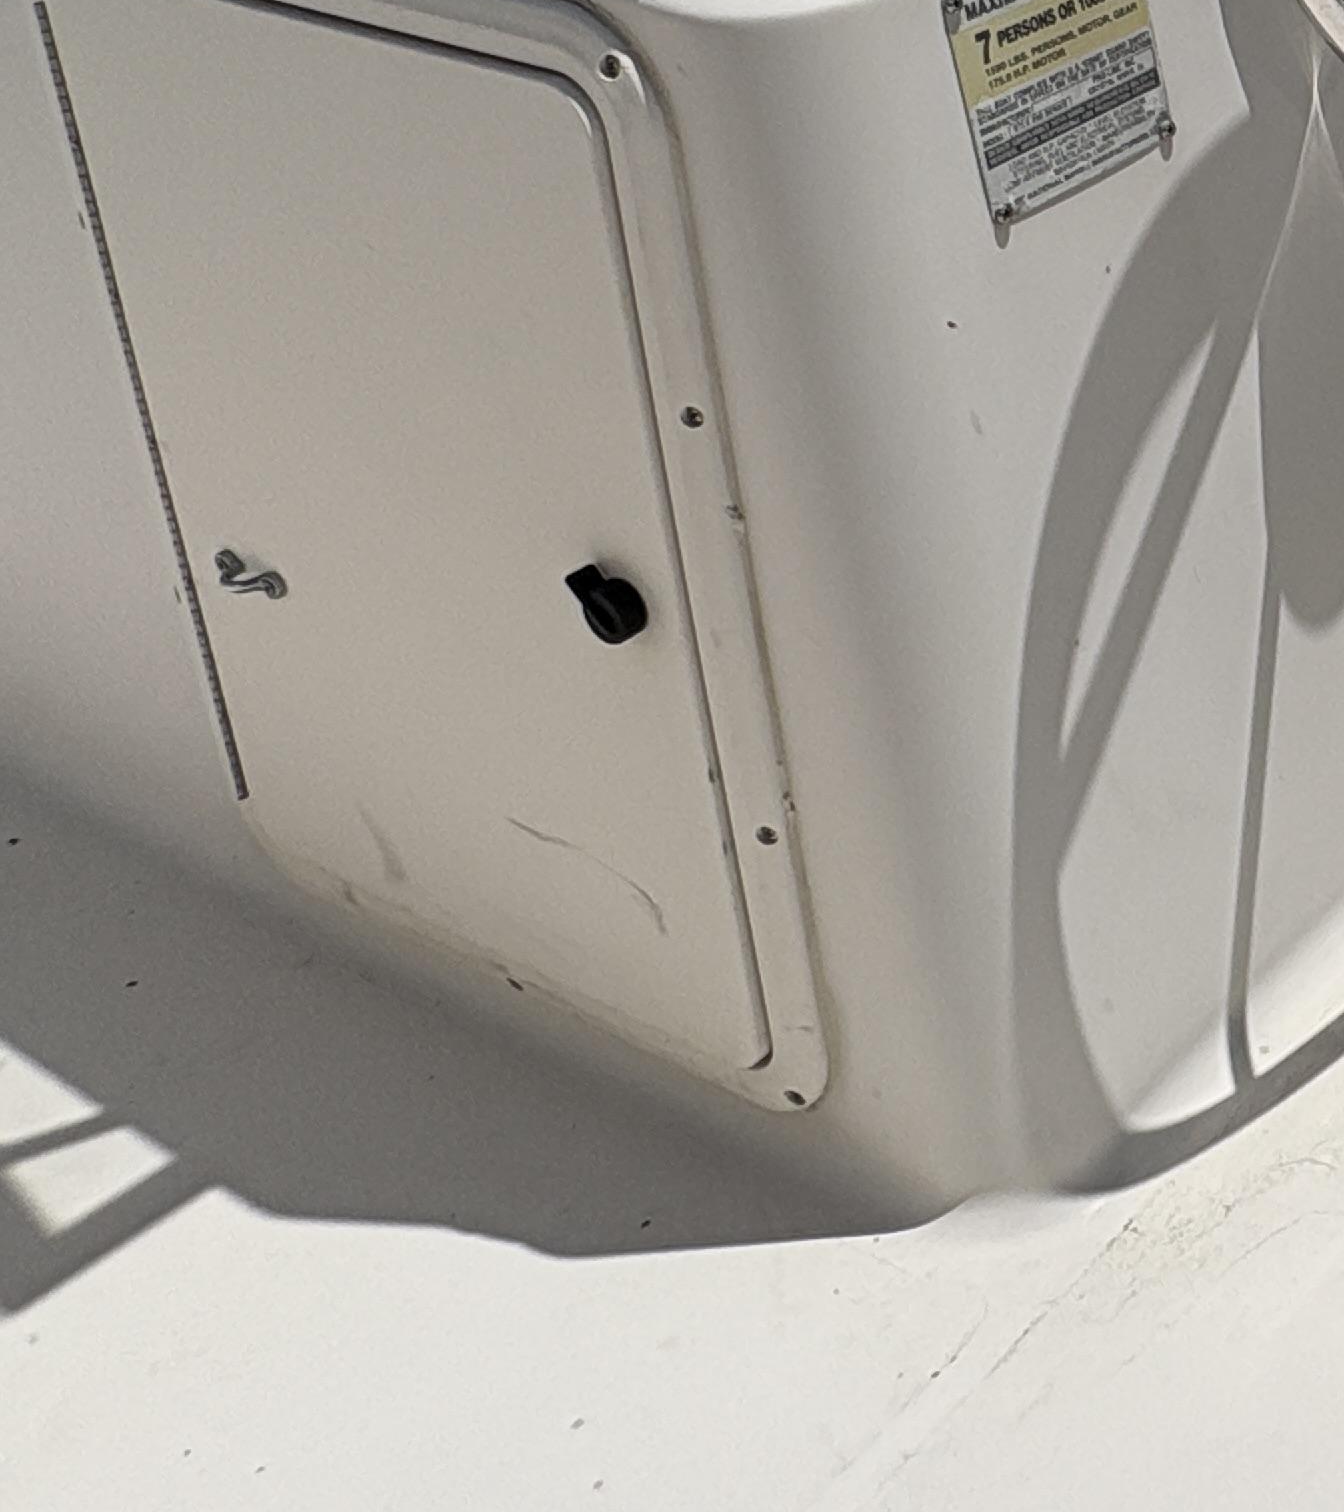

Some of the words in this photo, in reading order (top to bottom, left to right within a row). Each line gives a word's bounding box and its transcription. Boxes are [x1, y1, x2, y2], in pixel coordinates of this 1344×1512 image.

[975, 29, 991, 65] 7
[996, 7, 1057, 48] PERSONS
[1058, 0, 1077, 20] OR
[1031, 48, 1068, 70] MOTOR
